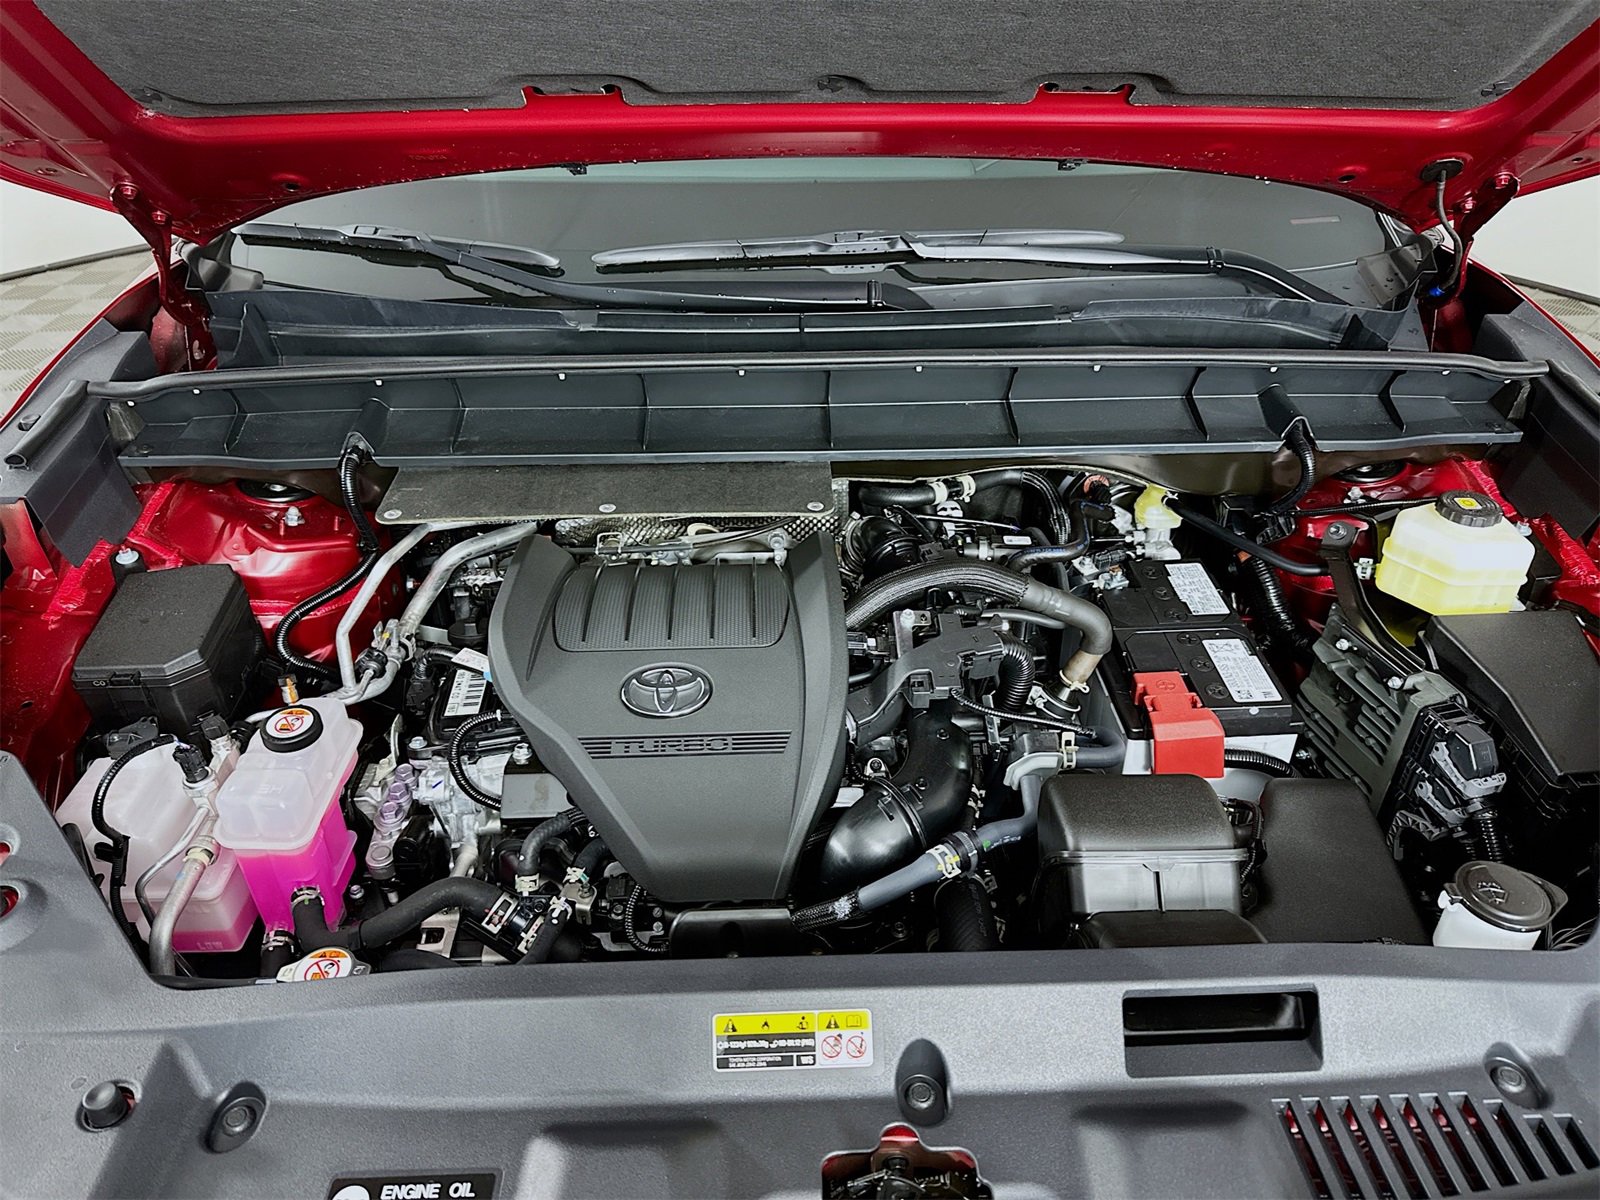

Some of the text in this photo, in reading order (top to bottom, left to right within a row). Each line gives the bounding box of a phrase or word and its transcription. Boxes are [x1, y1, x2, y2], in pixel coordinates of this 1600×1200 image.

[615, 736, 730, 754] TURBO
[196, 941, 223, 950] LOW
[380, 1182, 475, 1199] ENGINE OIL
